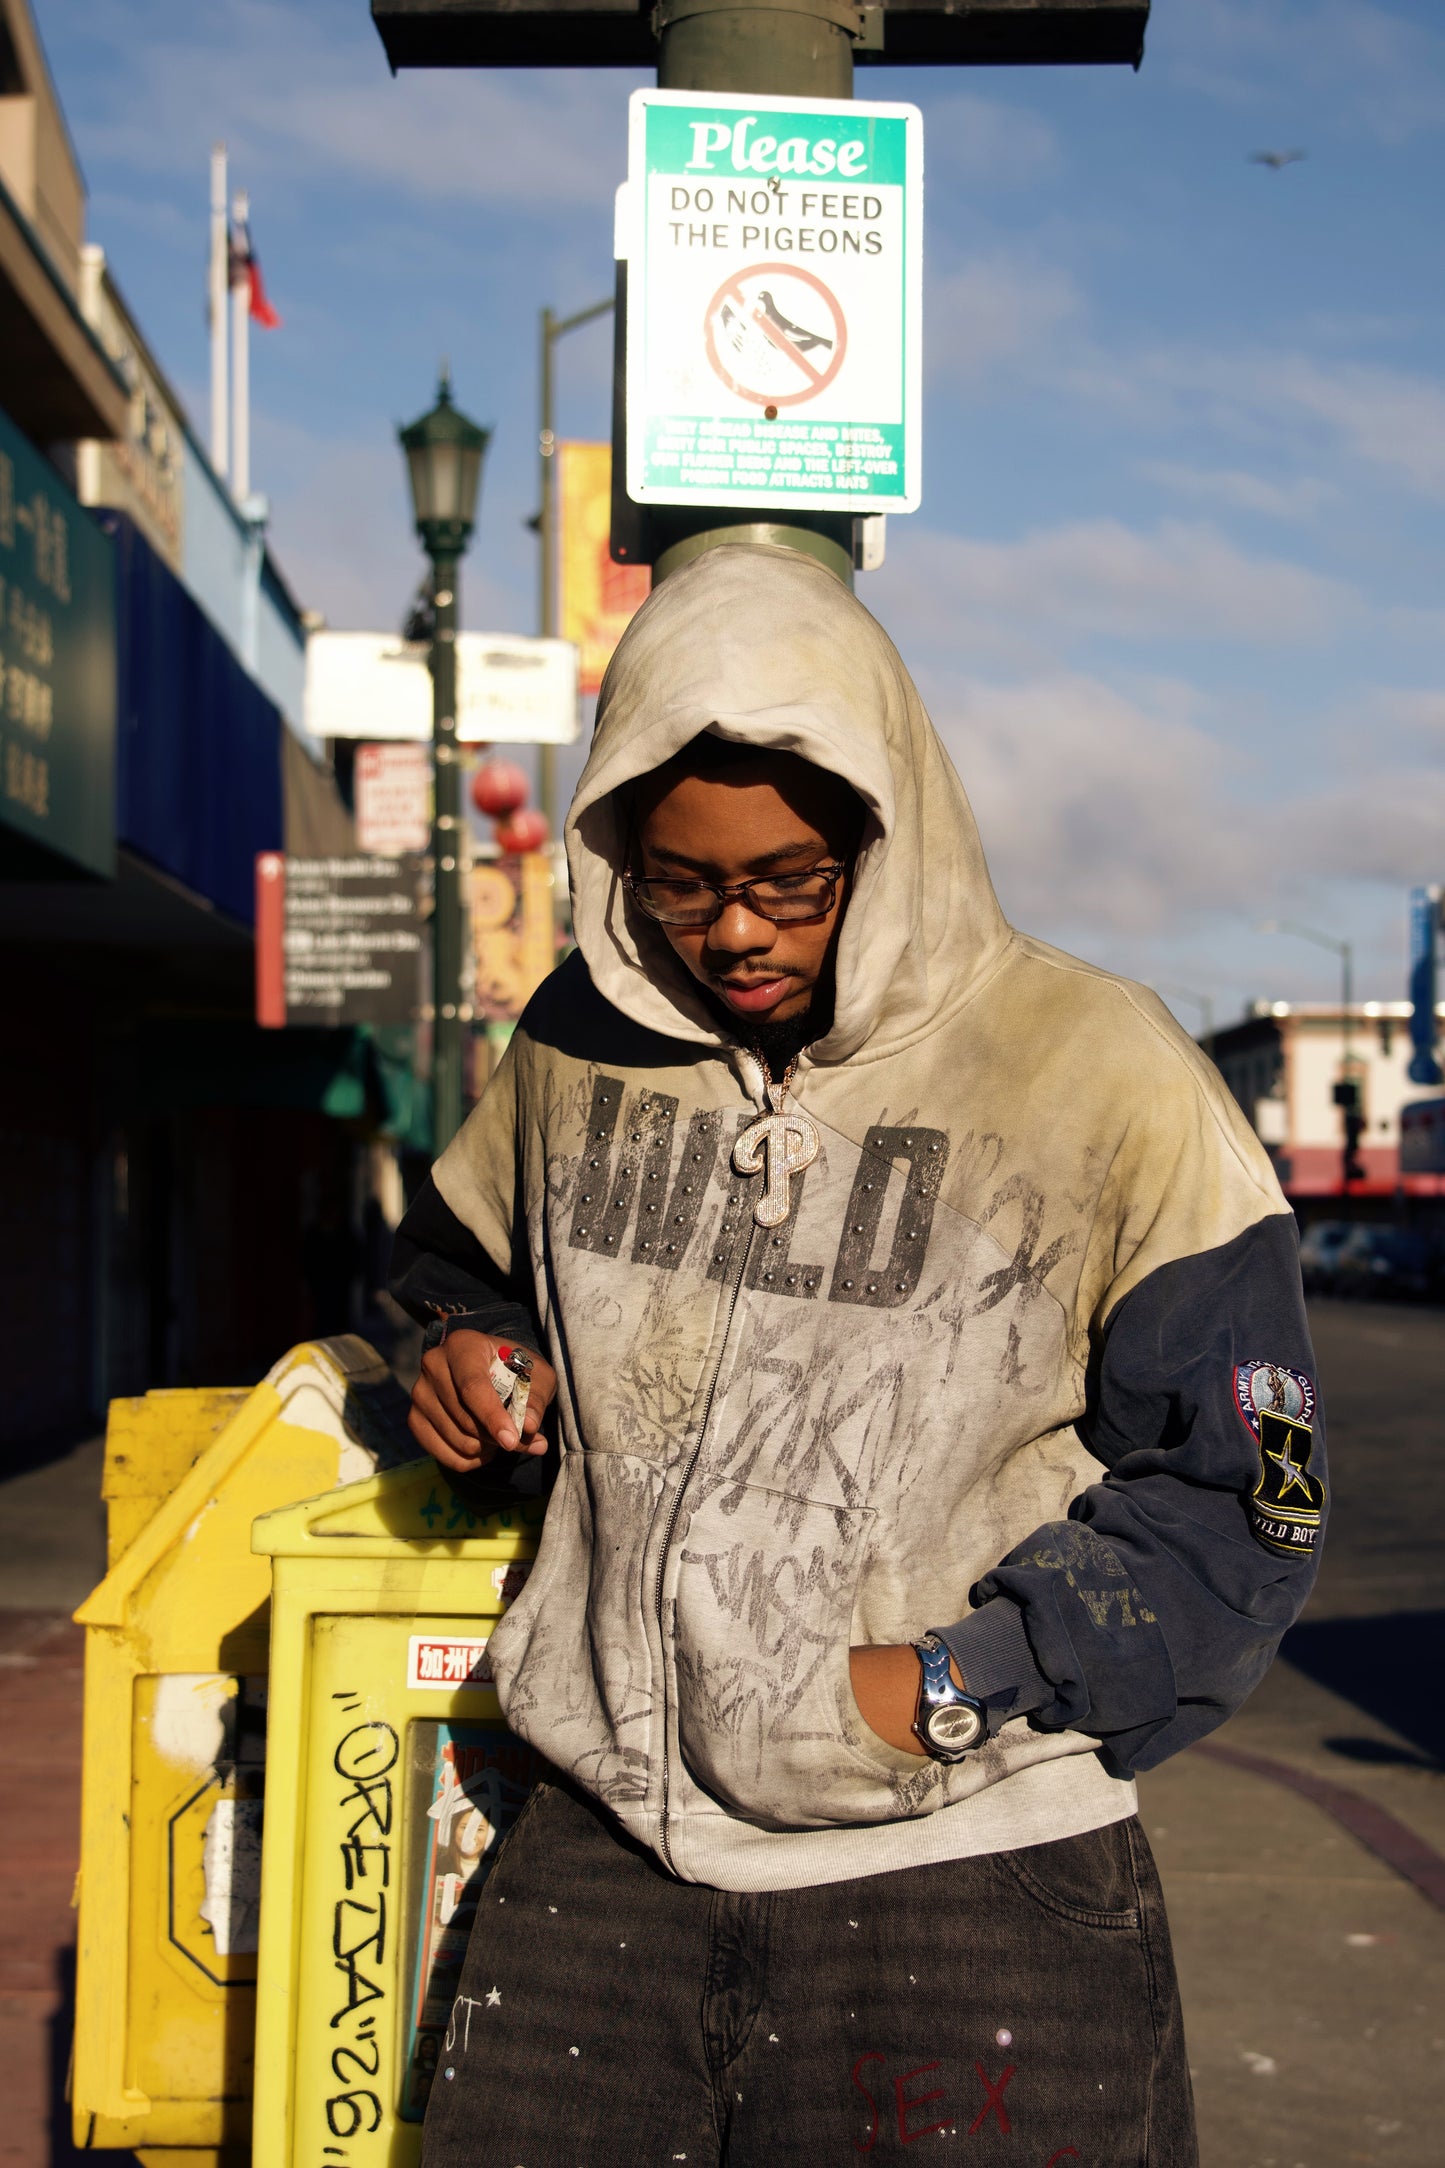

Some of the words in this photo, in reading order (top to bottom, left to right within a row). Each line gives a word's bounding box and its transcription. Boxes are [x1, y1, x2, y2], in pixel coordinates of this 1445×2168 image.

[685, 116, 868, 177] Please
[671, 187, 714, 212] DO
[728, 189, 789, 216] NOT
[802, 193, 882, 220] FEED
[669, 222, 728, 248] THE
[743, 225, 883, 255] PIGEONS
[774, 455, 802, 472] AND
[804, 457, 829, 473] THE
[832, 458, 898, 476] LEFT-OVER
[836, 442, 892, 459] DESTROY
[769, 471, 833, 489] ATTRACTS
[836, 474, 869, 490] RATS
[1238, 1372, 1255, 1412] ARMY
[852, 2051, 1018, 2153] SEX
